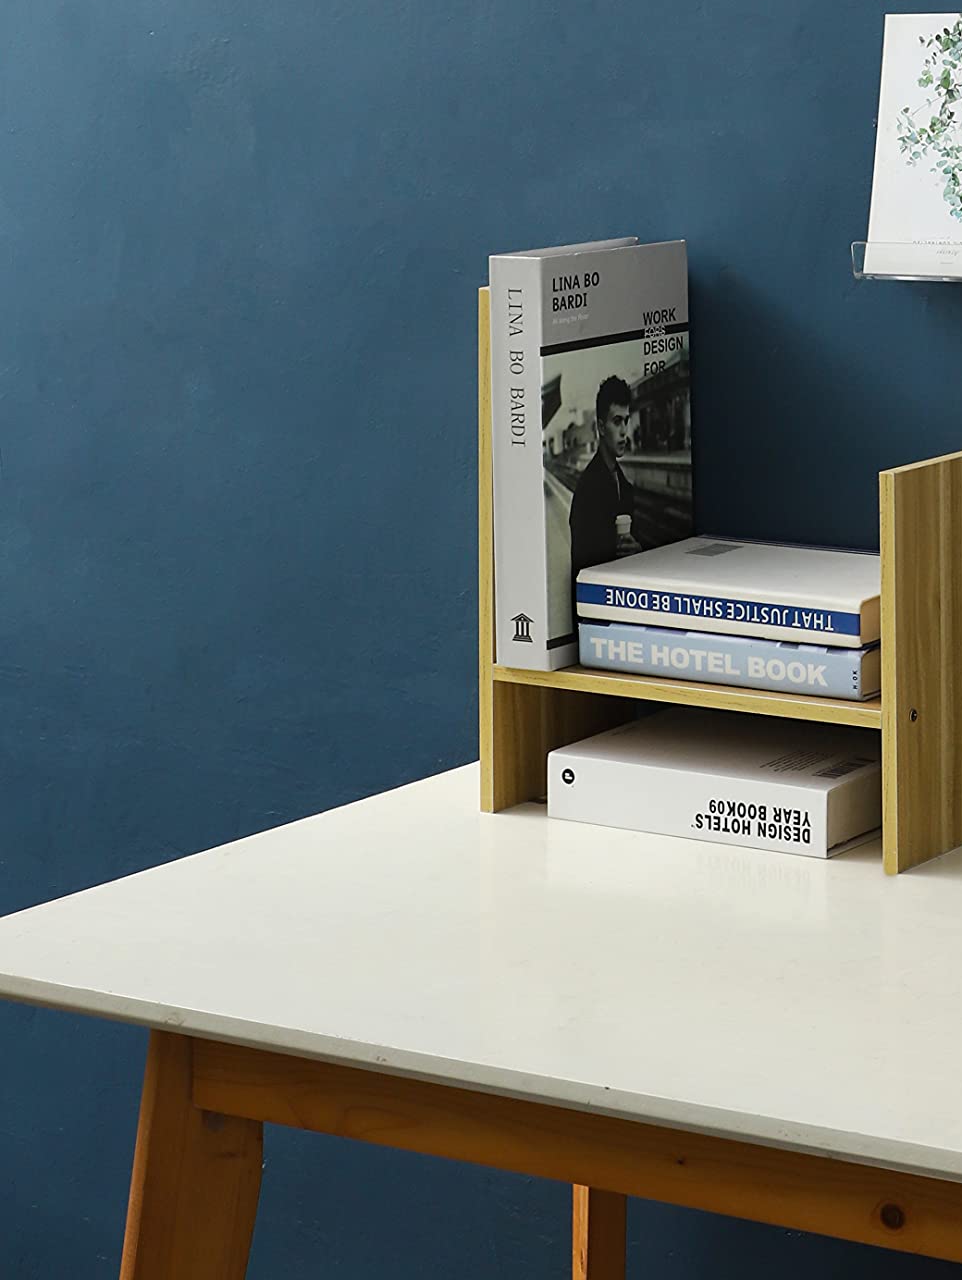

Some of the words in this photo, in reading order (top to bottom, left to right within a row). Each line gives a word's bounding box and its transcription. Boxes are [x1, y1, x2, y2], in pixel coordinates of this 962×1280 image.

[552, 275, 581, 293] LINA
[584, 272, 600, 288] BO
[507, 288, 523, 336] LINA
[552, 293, 588, 312] BARDI
[643, 308, 676, 326] WORK
[643, 336, 684, 355] DESIGN
[509, 350, 525, 375] BO
[644, 360, 666, 376] FOR
[510, 387, 526, 447] BARDI
[605, 588, 648, 608] DONE
[652, 594, 670, 611] BE
[674, 596, 723, 617] SHALL
[726, 602, 789, 625] JUSTICE
[791, 610, 834, 631] THAT
[590, 637, 644, 664] THE
[650, 644, 740, 675] HOTEL
[747, 656, 828, 687] BOOK
[709, 799, 767, 821] BOOK09
[773, 807, 811, 827] YEAR
[757, 821, 811, 844] DESIGN
